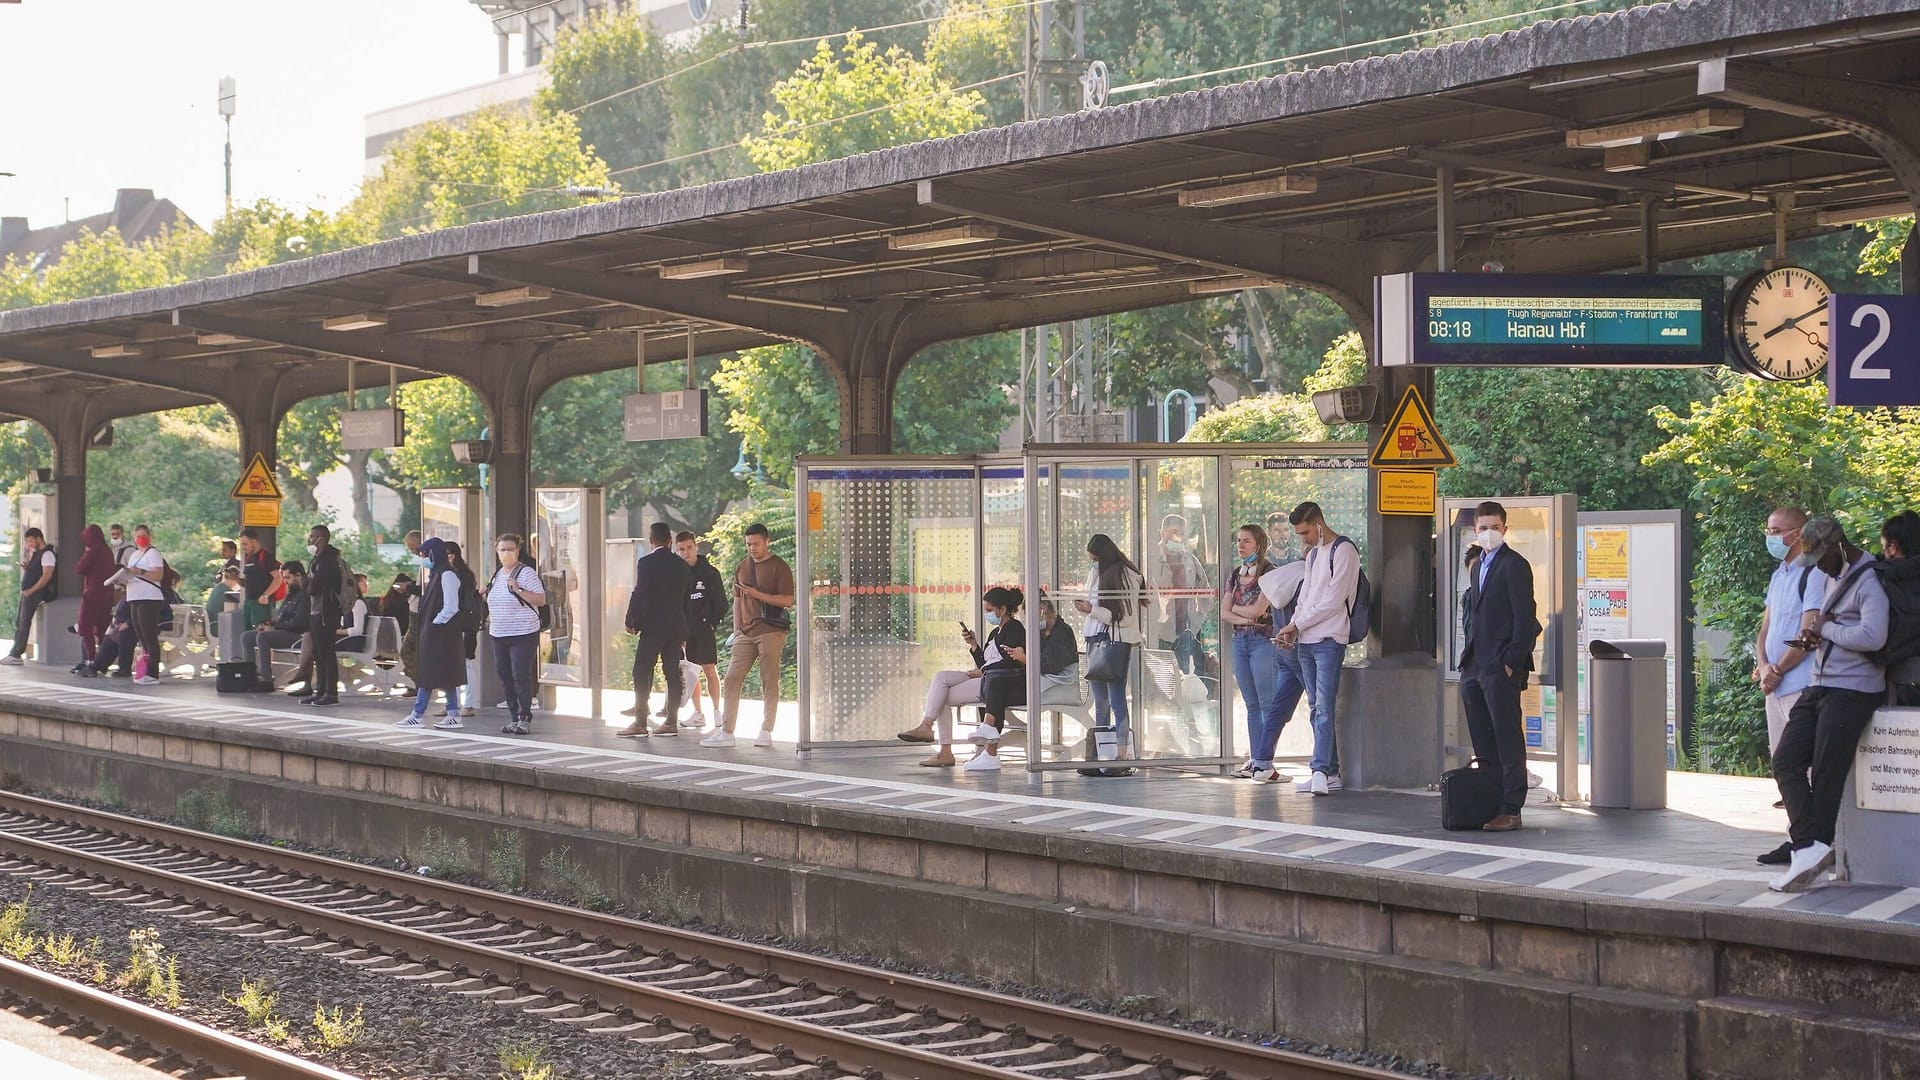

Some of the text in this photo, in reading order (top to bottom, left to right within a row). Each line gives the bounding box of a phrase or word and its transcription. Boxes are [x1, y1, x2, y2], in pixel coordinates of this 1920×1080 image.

[1495, 298, 1515, 307] Bitte
[1517, 298, 1554, 308] beachten
[1556, 298, 1568, 308] Sie
[1570, 299, 1581, 308] die
[1582, 299, 1590, 308] in
[1593, 299, 1606, 308] den
[1651, 300, 1666, 309] und
[1429, 309, 1442, 317] S 8
[1507, 309, 1529, 319] Flugh
[1531, 310, 1572, 319] Regionalbf
[1580, 310, 1618, 319] F-Stadion
[1625, 310, 1663, 319] Frankfurt
[1665, 311, 1679, 319] Hbf
[1429, 321, 1471, 337] 08:18
[1507, 321, 1586, 338] Hanau Hbf
[1849, 303, 1891, 379] 2
[1589, 591, 1610, 600] ORTHO
[1589, 607, 1610, 616] COSAR
[1873, 727, 1887, 735] Kein
[1870, 764, 1881, 772] und
[1883, 764, 1902, 774] Mauer
